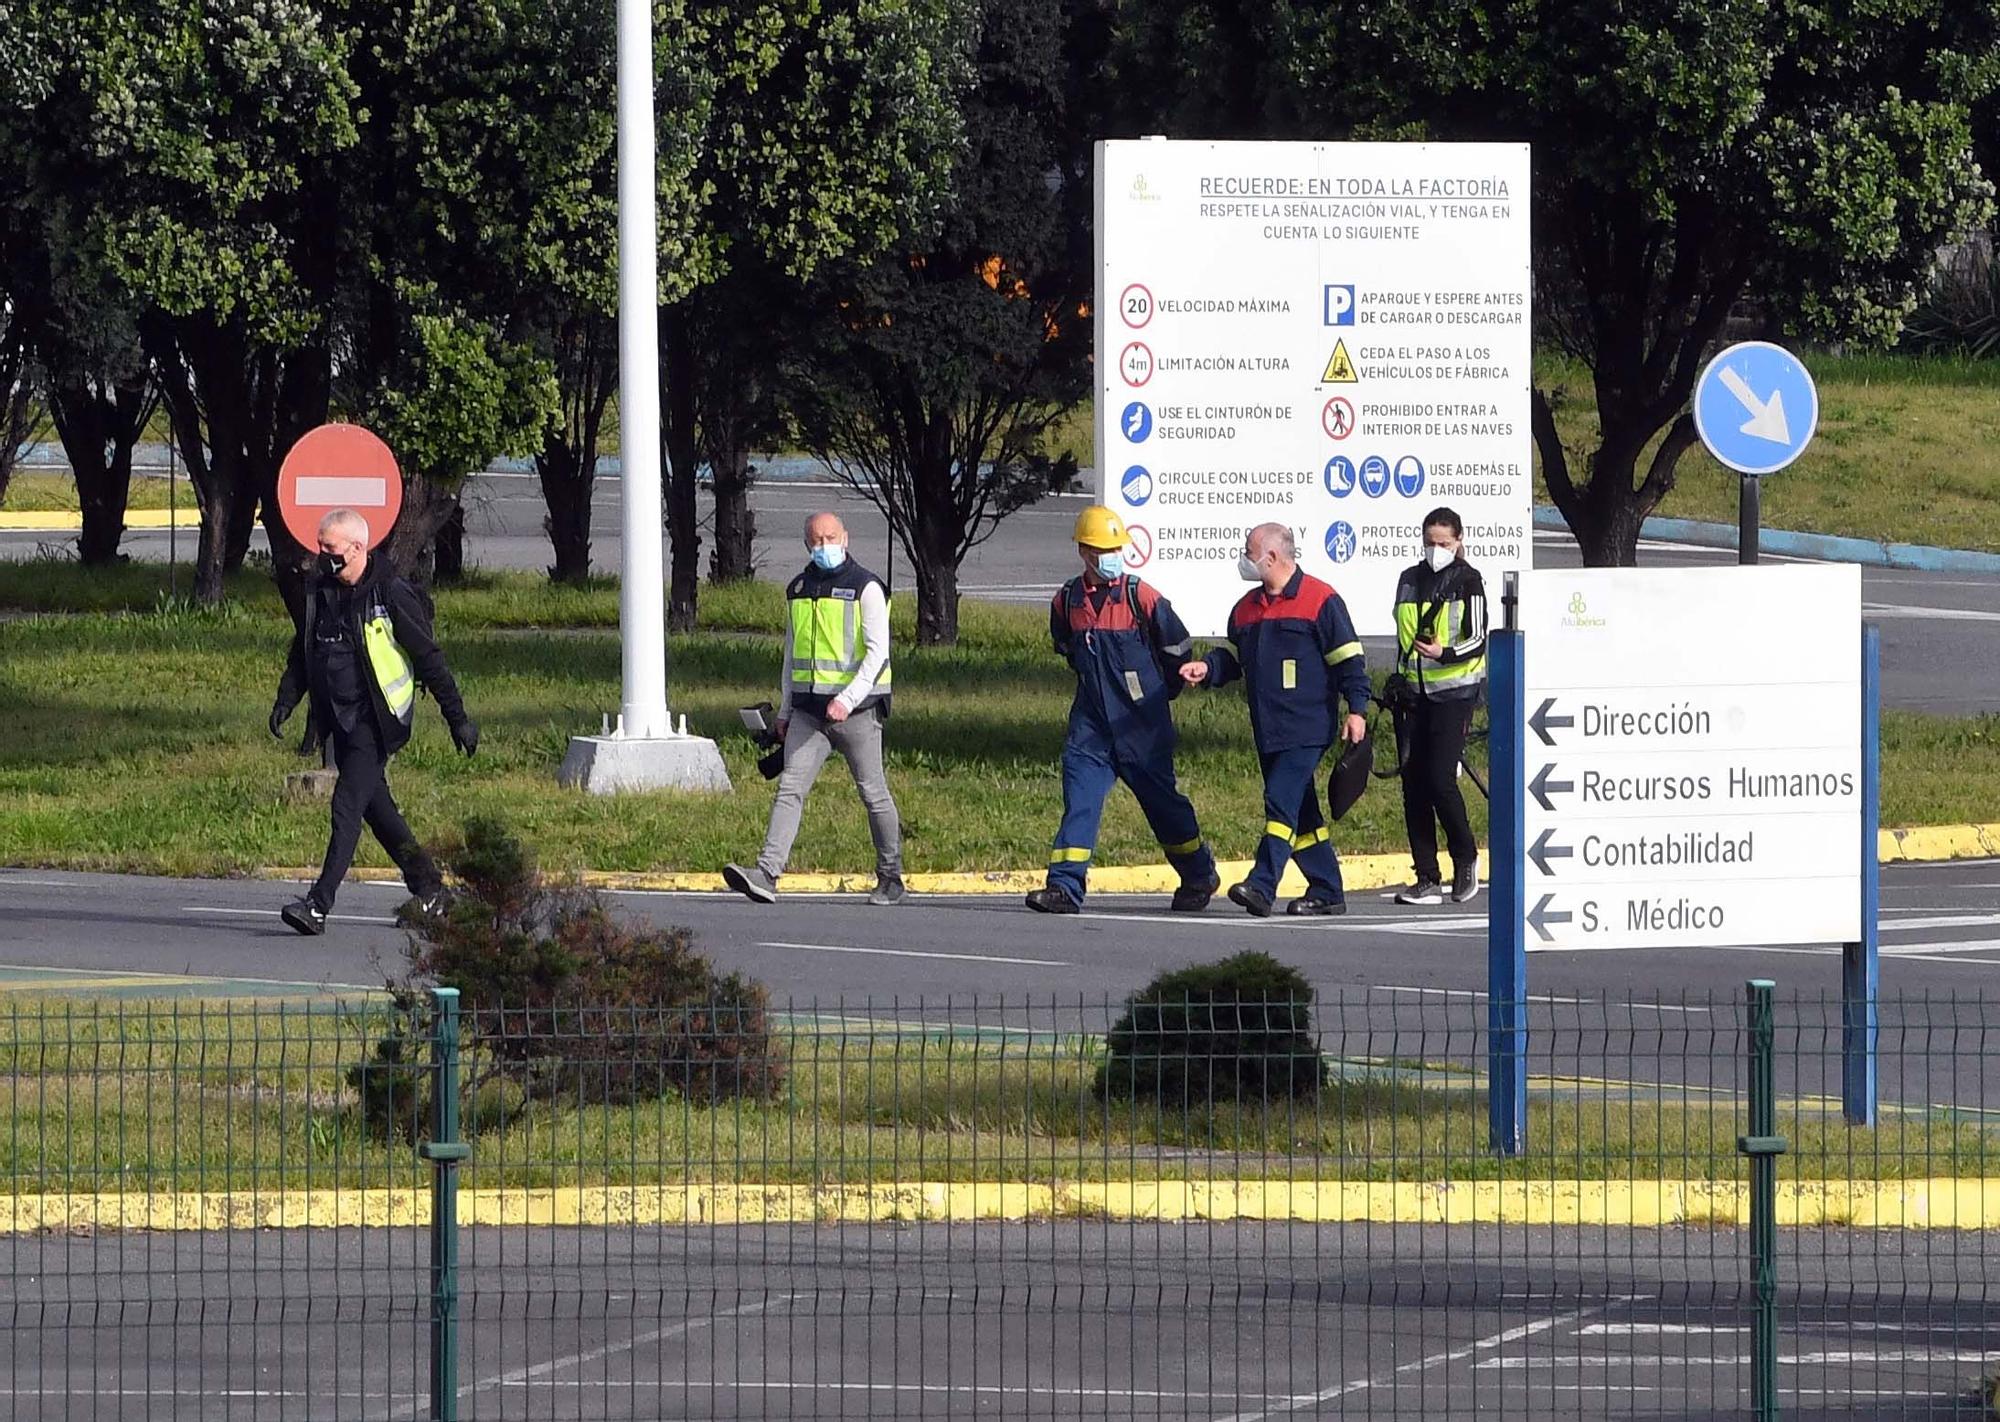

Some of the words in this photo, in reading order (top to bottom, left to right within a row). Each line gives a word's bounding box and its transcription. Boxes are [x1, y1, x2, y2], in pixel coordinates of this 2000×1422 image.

[1201, 178, 1303, 194] RECUERDE:
[1309, 179, 1330, 194] EN
[1337, 179, 1385, 195] TODA
[1392, 180, 1413, 195] LA
[1420, 176, 1508, 196] FACTORÍA
[1201, 204, 1258, 217] RESPETE
[1263, 205, 1278, 217] LA
[1284, 200, 1385, 218] SEÑALIZACIÓN
[1391, 205, 1425, 219] VIAL,
[1430, 206, 1437, 218] Y
[1442, 206, 1487, 218] TENGA
[1493, 206, 1509, 218] EN
[1264, 226, 1317, 239] CUENTA
[1324, 227, 1341, 239] LO
[1346, 227, 1418, 239] SIGUIENTE
[1159, 301, 1234, 312] VELOCIDAD
[1239, 298, 1290, 312] MÁXIMA
[1329, 287, 1352, 324] P
[1361, 293, 1420, 305] APARQUE
[1424, 293, 1431, 305] Y
[1435, 293, 1480, 305] ESPERE
[1485, 294, 1522, 305] ANTES
[1128, 299, 1147, 314] 20
[1361, 312, 1375, 323] DE
[1380, 312, 1431, 324] CARGAR
[1436, 312, 1443, 324] O
[1448, 312, 1521, 324] DESCARGAR
[1360, 347, 1394, 359] CEDA
[1399, 348, 1412, 359] EL
[1417, 348, 1451, 359] PASO
[1455, 348, 1463, 359] A
[1466, 348, 1490, 359] LOS
[1128, 358, 1147, 371] 4m
[1159, 354, 1234, 370] LIMITACIÓN
[1238, 358, 1289, 370] ALTURA
[1361, 363, 1432, 378] VEHÍCULOS
[1436, 367, 1451, 378] DE
[1456, 363, 1508, 378] FÁBRICA
[1159, 407, 1182, 419] USE
[1187, 407, 1201, 419] EL
[1205, 403, 1271, 419] CINTURÓN
[1276, 407, 1291, 419] DE
[1363, 405, 1433, 416] PROHIBIDO
[1437, 405, 1486, 416] ENTRAR
[1490, 405, 1498, 416] A
[1159, 427, 1235, 439] SEGURIDAD
[1363, 424, 1421, 435] INTERIOR
[1425, 424, 1440, 435] DE
[1445, 424, 1467, 435] LAS
[1472, 424, 1512, 435] NAVES
[1430, 464, 1452, 476] USE
[1456, 460, 1504, 476] ADEMÁS
[1508, 464, 1521, 476] EL
[1159, 472, 1215, 484] CIRCULE
[1219, 472, 1247, 484] CON
[1252, 472, 1293, 484] LUCES
[1297, 472, 1313, 484] DE
[1431, 484, 1511, 496] BARBUQUEJO
[1159, 492, 1204, 504] CRUCE
[1208, 492, 1293, 504] ENCENDIDAS
[1159, 528, 1175, 539] EN
[1180, 528, 1240, 539] INTERIOR
[1299, 527, 1307, 539] Y
[1362, 526, 1421, 538] PROTECC
[1467, 522, 1523, 538] TICAÍDAS
[1159, 547, 1226, 560] ESPACIOS
[1362, 542, 1388, 557] MÁS
[1393, 545, 1408, 557] DE
[1583, 702, 1710, 737] Dirección
[1582, 770, 1711, 803] Recursos
[1729, 767, 1854, 799] Humanos
[1583, 831, 1753, 867] Contabilidad
[1582, 900, 1608, 933] S.
[1627, 898, 1724, 931] Médico
